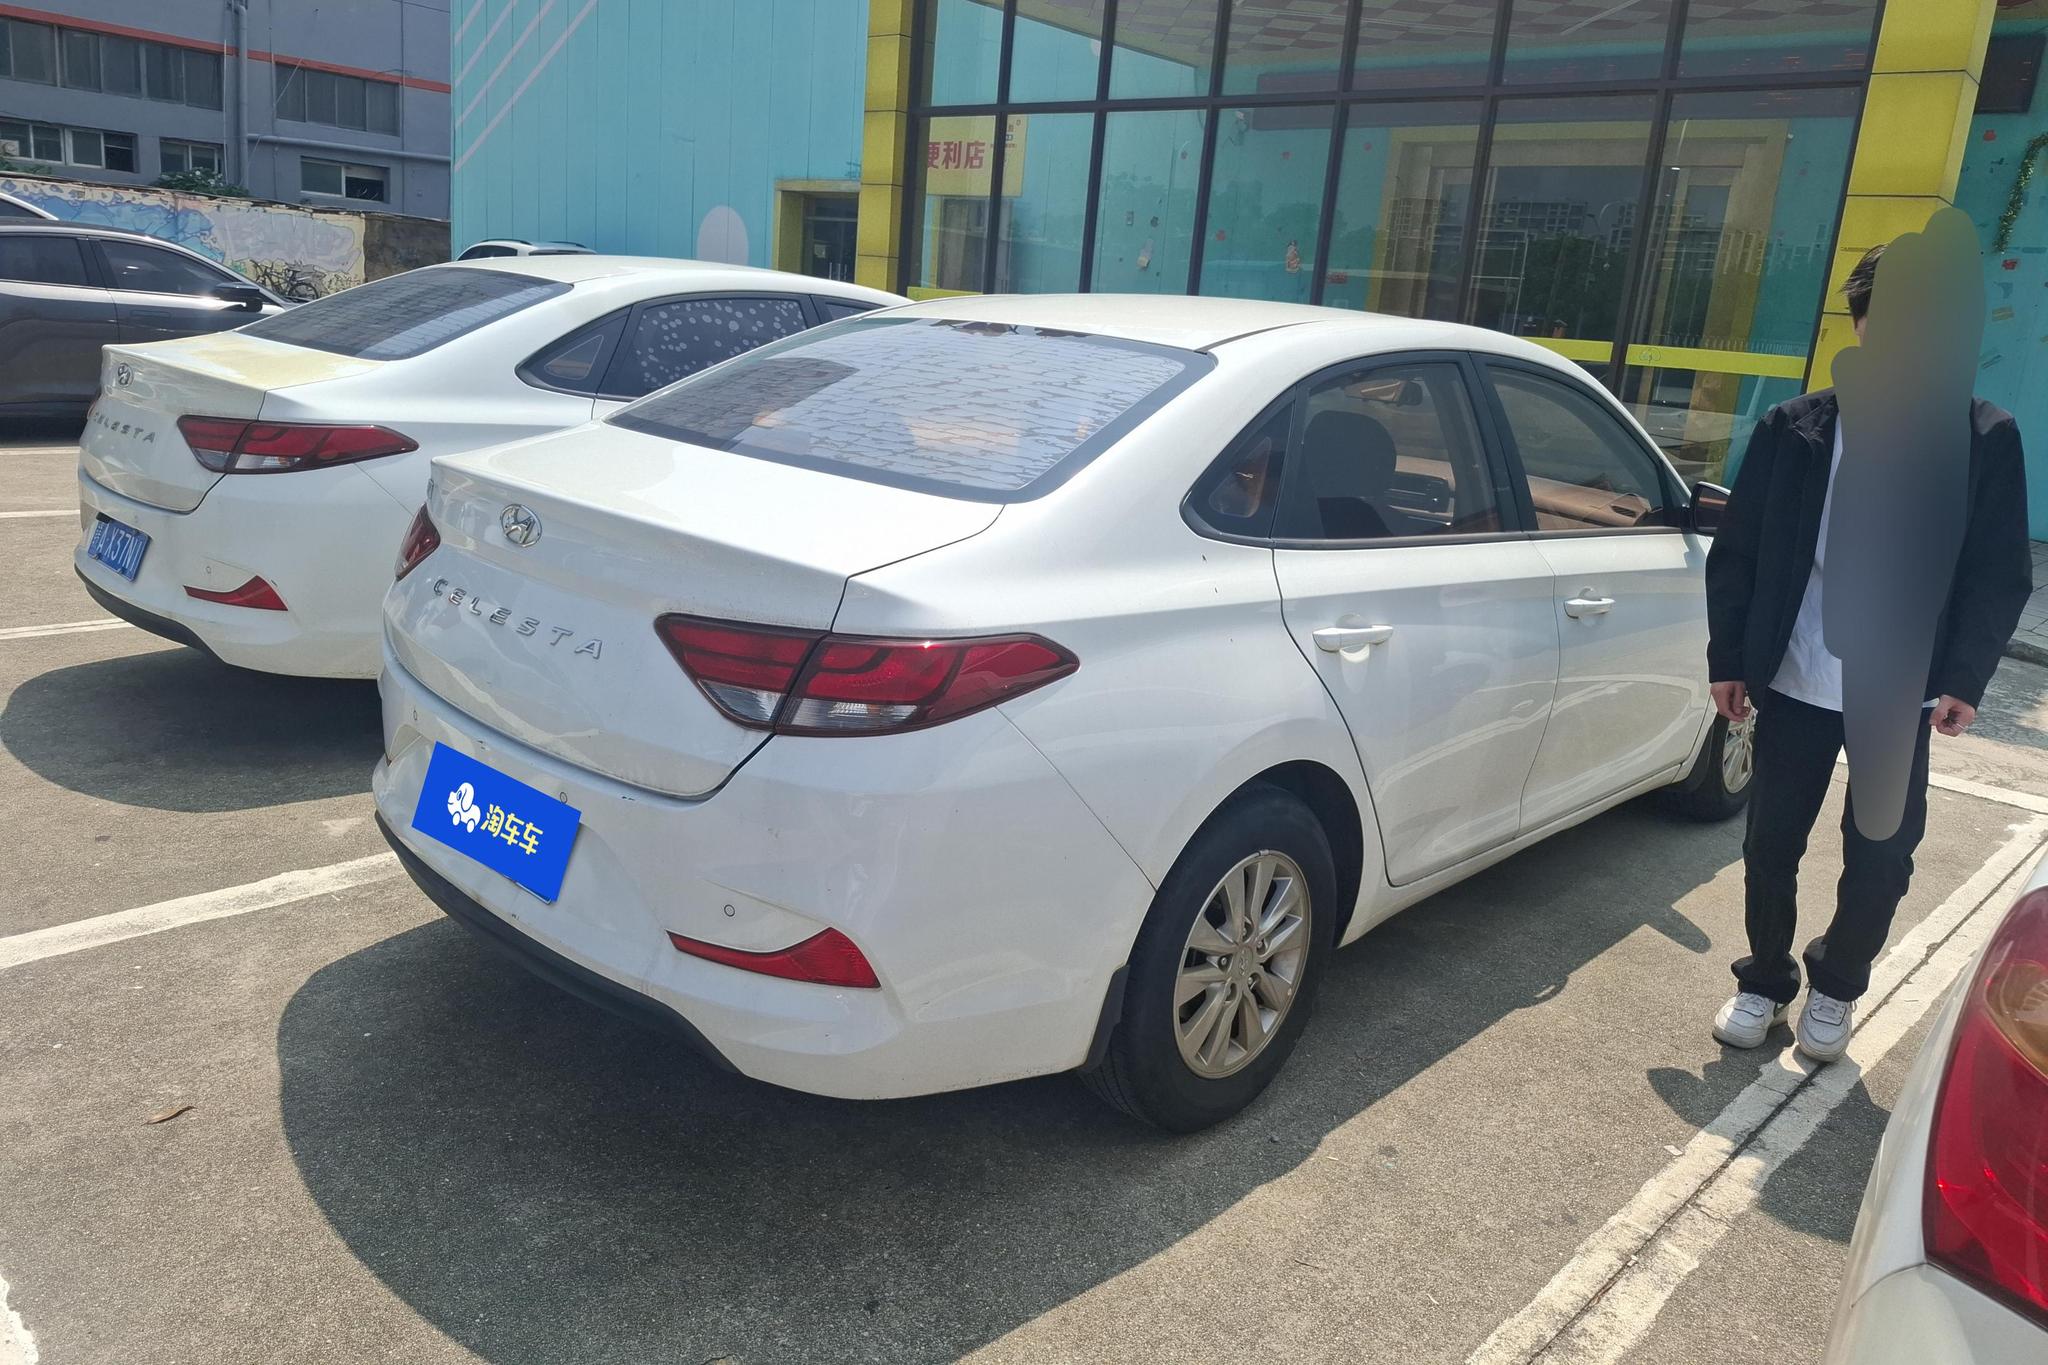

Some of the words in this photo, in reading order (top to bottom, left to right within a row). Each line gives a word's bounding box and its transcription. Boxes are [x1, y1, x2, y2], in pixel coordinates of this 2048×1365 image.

[927, 140, 985, 169] 便利店
[433, 578, 603, 659] CELESTA
